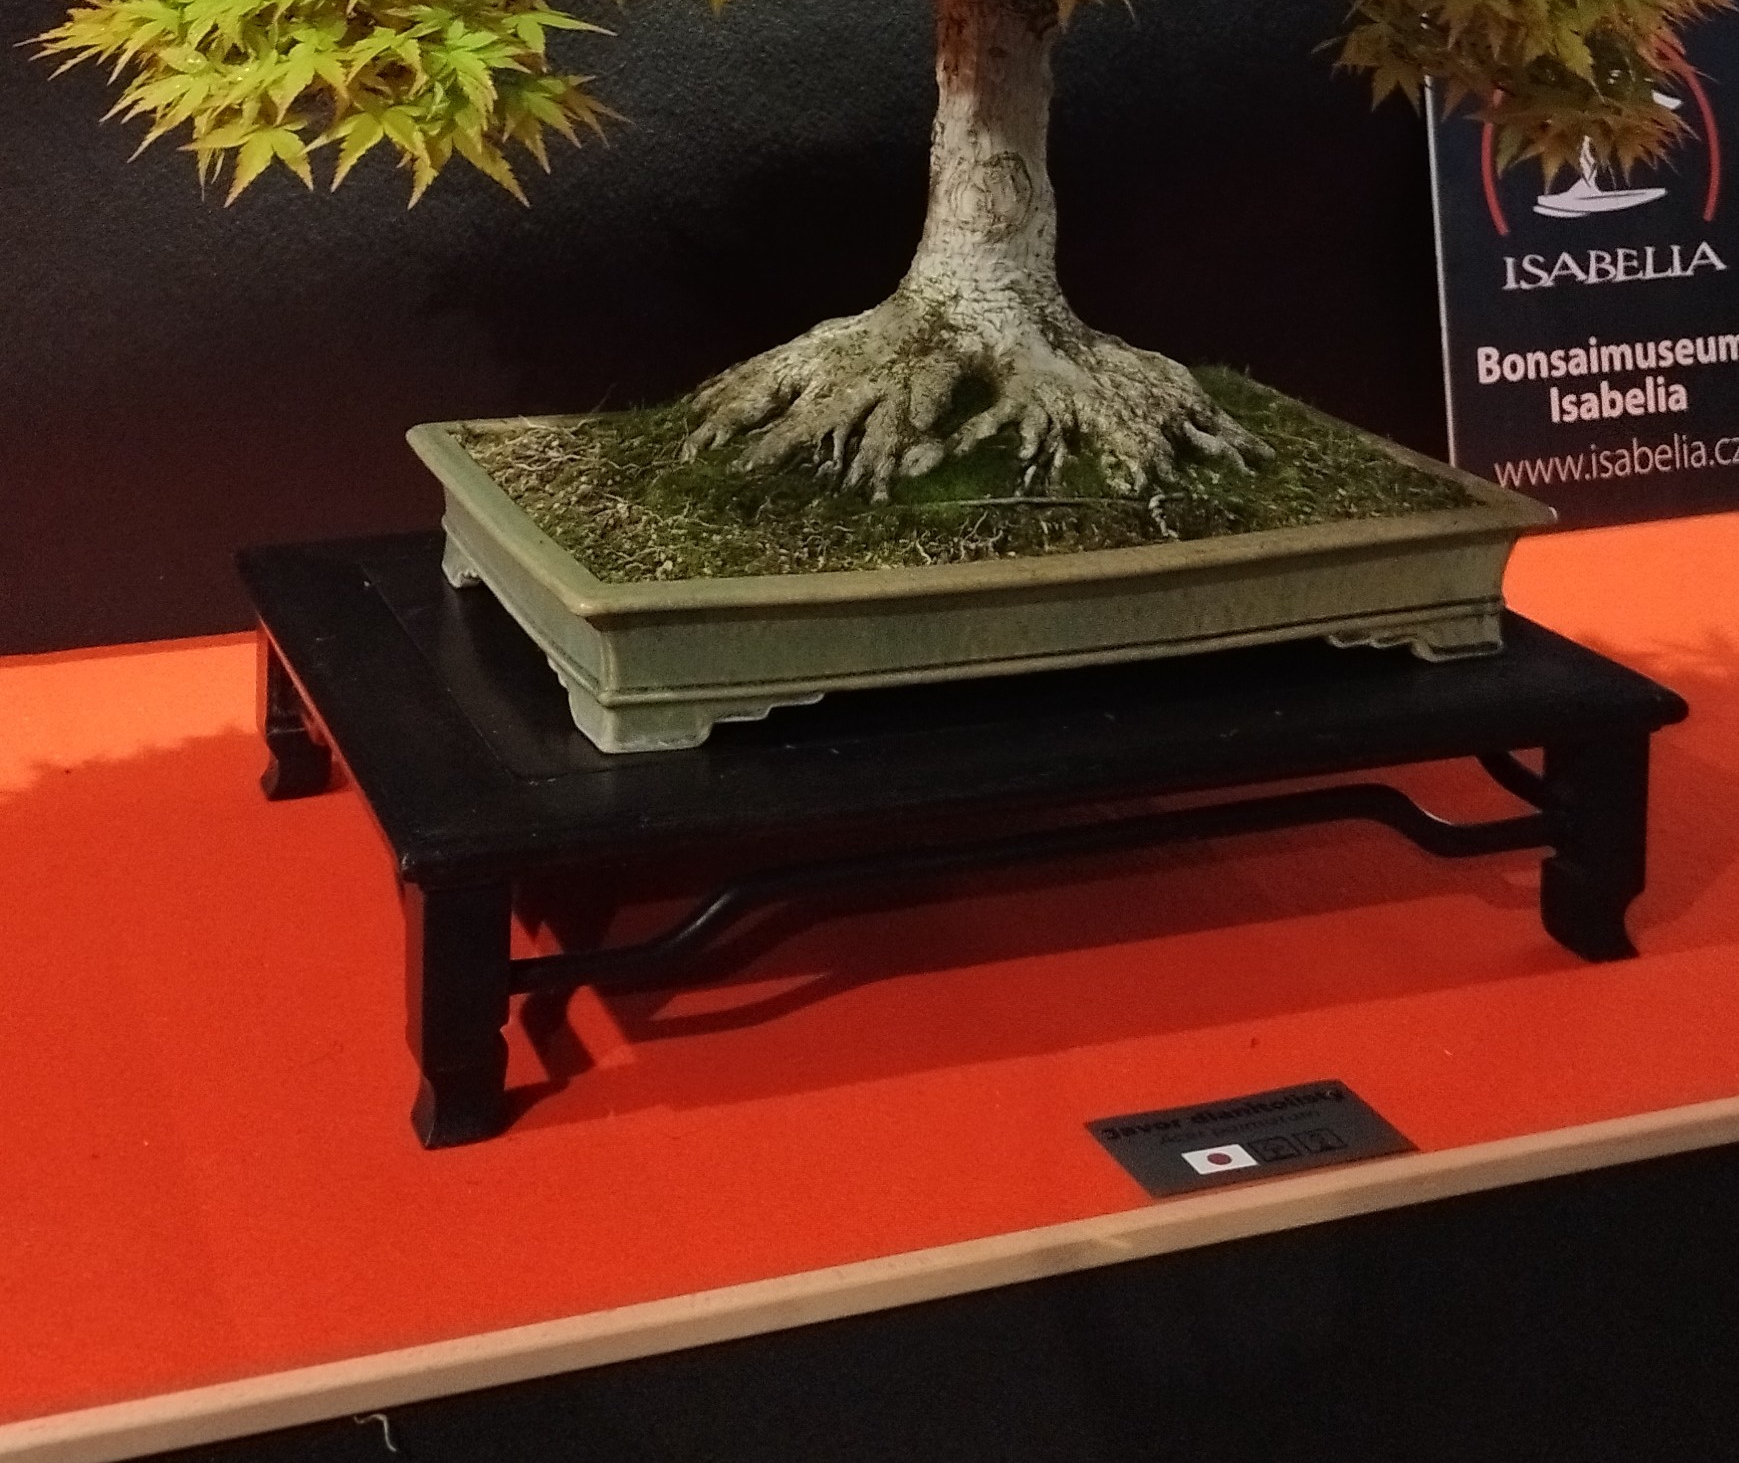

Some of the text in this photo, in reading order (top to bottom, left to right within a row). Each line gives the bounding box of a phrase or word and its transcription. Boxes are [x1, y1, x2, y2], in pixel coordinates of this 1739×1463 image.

[1503, 241, 1727, 290] ISABELIA
[1477, 334, 1739, 384] Bonsaimuseum
[1550, 375, 1688, 423] Isabelia
